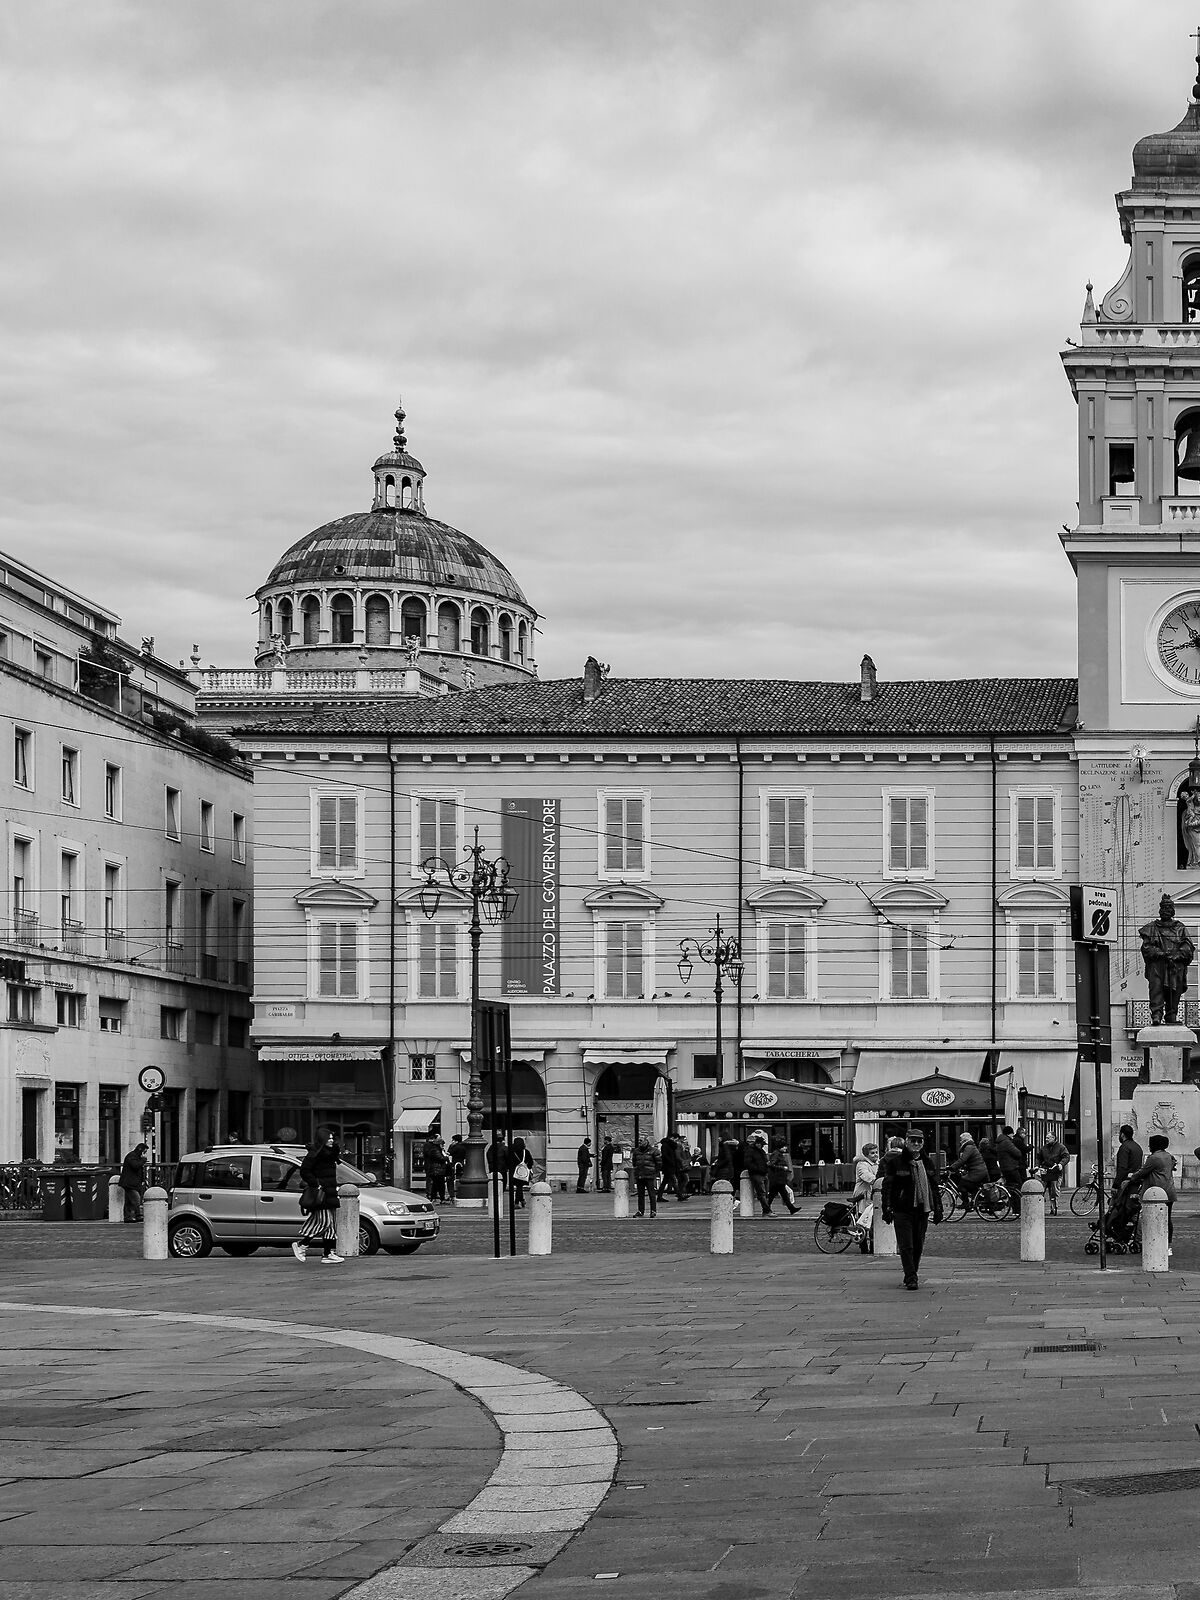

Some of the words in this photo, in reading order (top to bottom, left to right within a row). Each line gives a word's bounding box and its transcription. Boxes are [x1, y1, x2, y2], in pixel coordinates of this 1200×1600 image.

[1166, 623, 1178, 632] X
[543, 800, 555, 903] GOVERNATORE
[543, 906, 555, 929] DEL
[543, 933, 555, 994] PALAZZO
